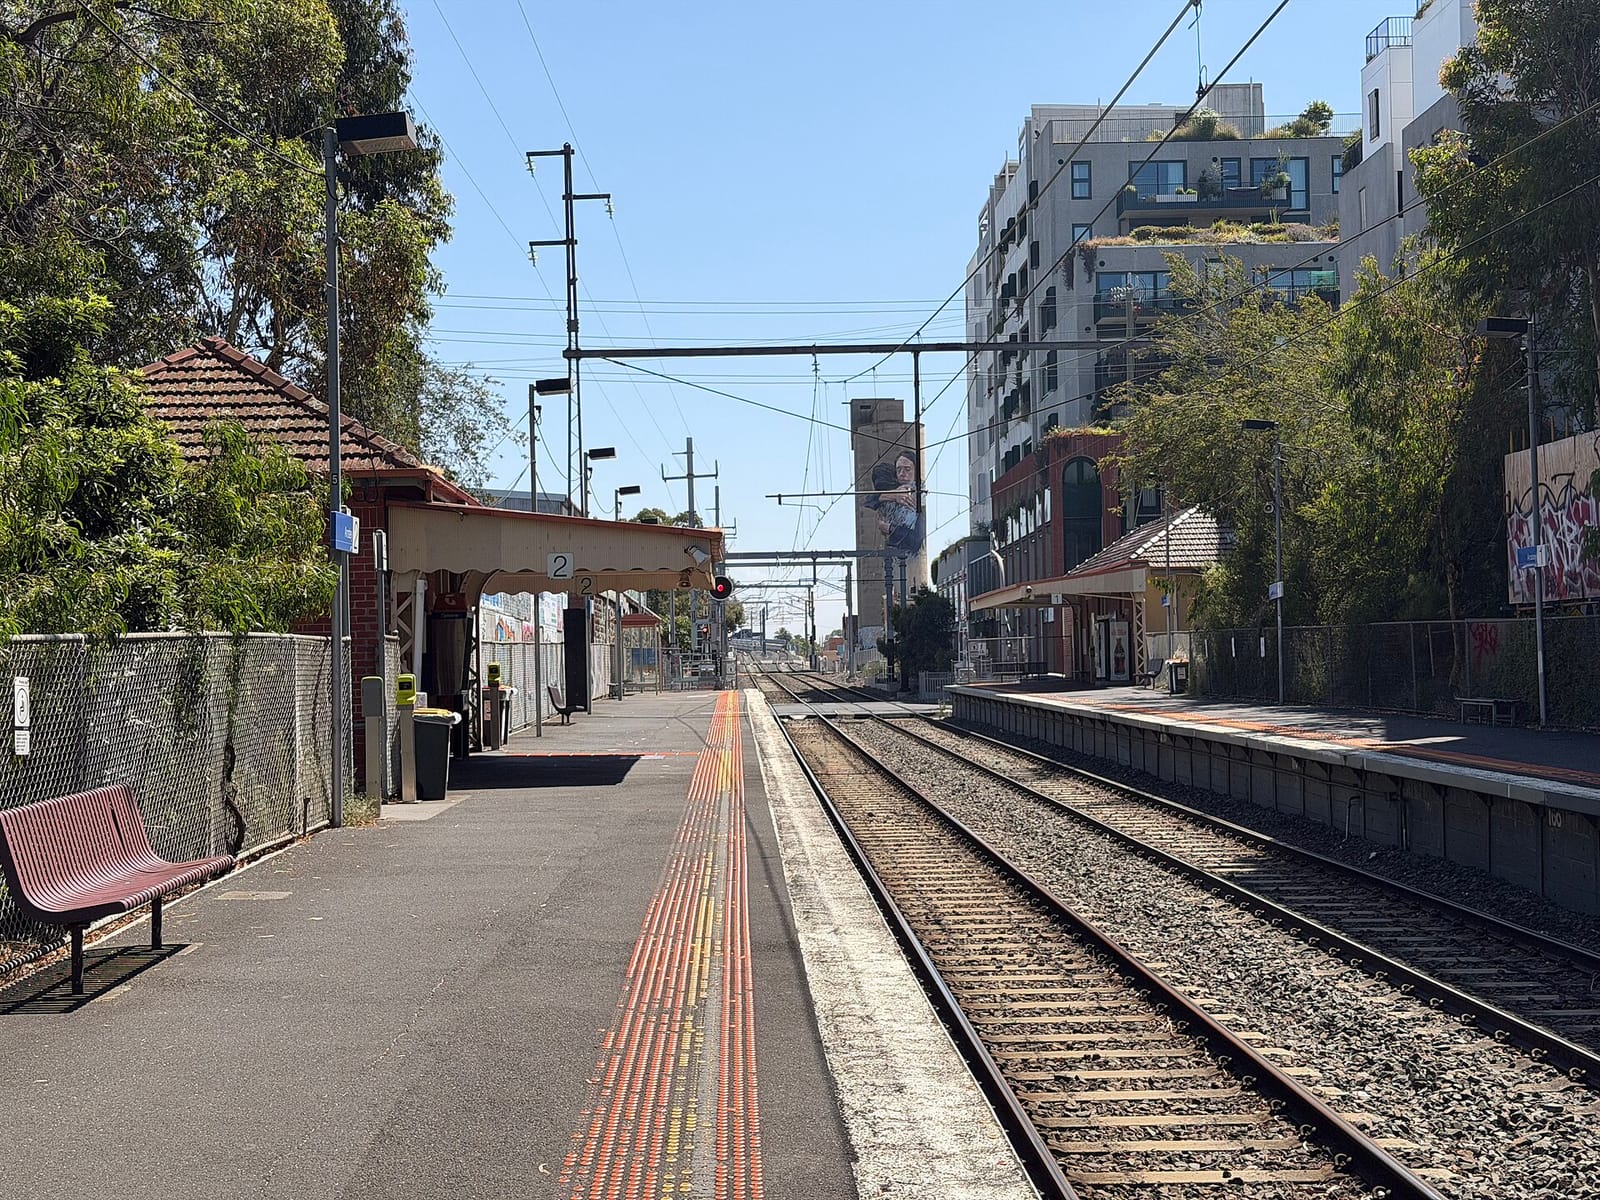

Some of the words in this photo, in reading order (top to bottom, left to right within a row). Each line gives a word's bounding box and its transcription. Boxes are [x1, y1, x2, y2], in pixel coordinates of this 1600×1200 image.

[332, 476, 338, 484] 5
[554, 555, 567, 577] 2
[581, 577, 592, 594] 2
